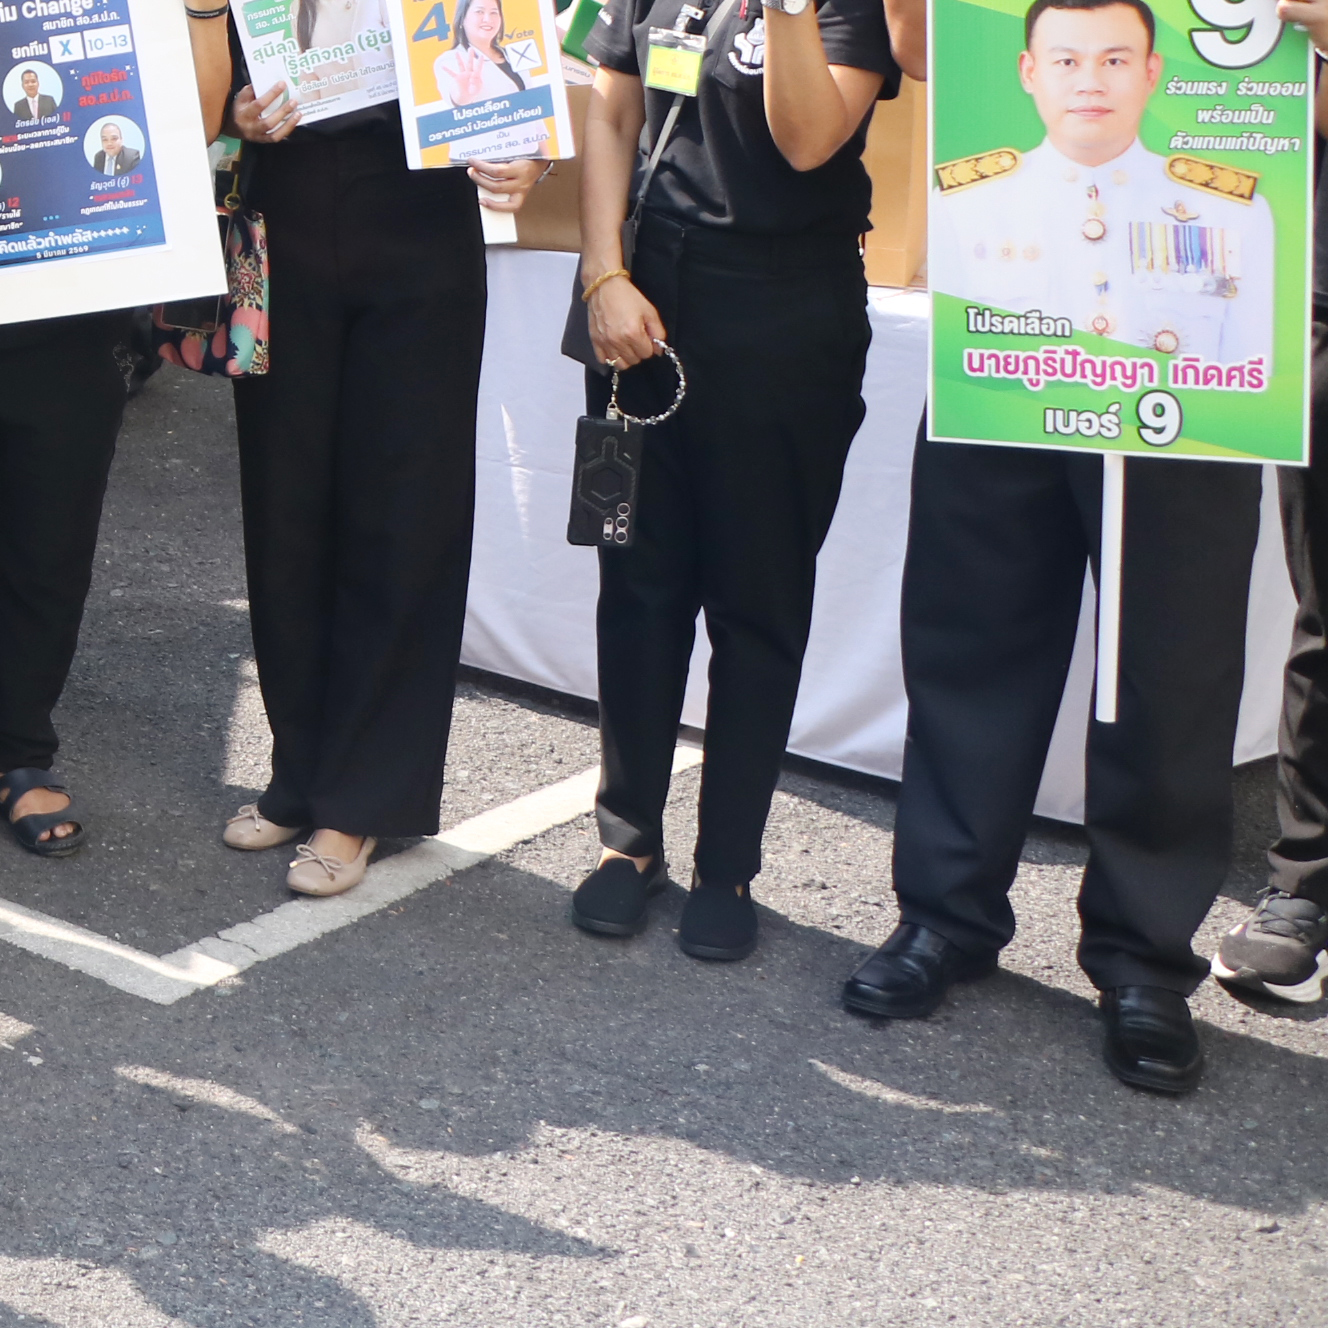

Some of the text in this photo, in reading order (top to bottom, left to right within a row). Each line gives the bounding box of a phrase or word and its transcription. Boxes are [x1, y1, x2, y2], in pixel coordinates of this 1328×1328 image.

[412, 2, 451, 42] 4
[88, 34, 128, 51] 10-13
[1166, 76, 1306, 97] ร่วมแรง ร่วมออม
[453, 99, 510, 120] โปรดเลือก
[1196, 103, 1274, 125] พร้อมเป็น
[1170, 132, 1301, 155] ตัวแทนแก้ปัญหา
[69, 245, 89, 256] 2569
[966, 306, 1072, 338] โปรดเลือก
[966, 349, 1265, 389] นายภูริปัญญา เกิดศรี
[1043, 389, 1183, 447] เบอร์ 9
